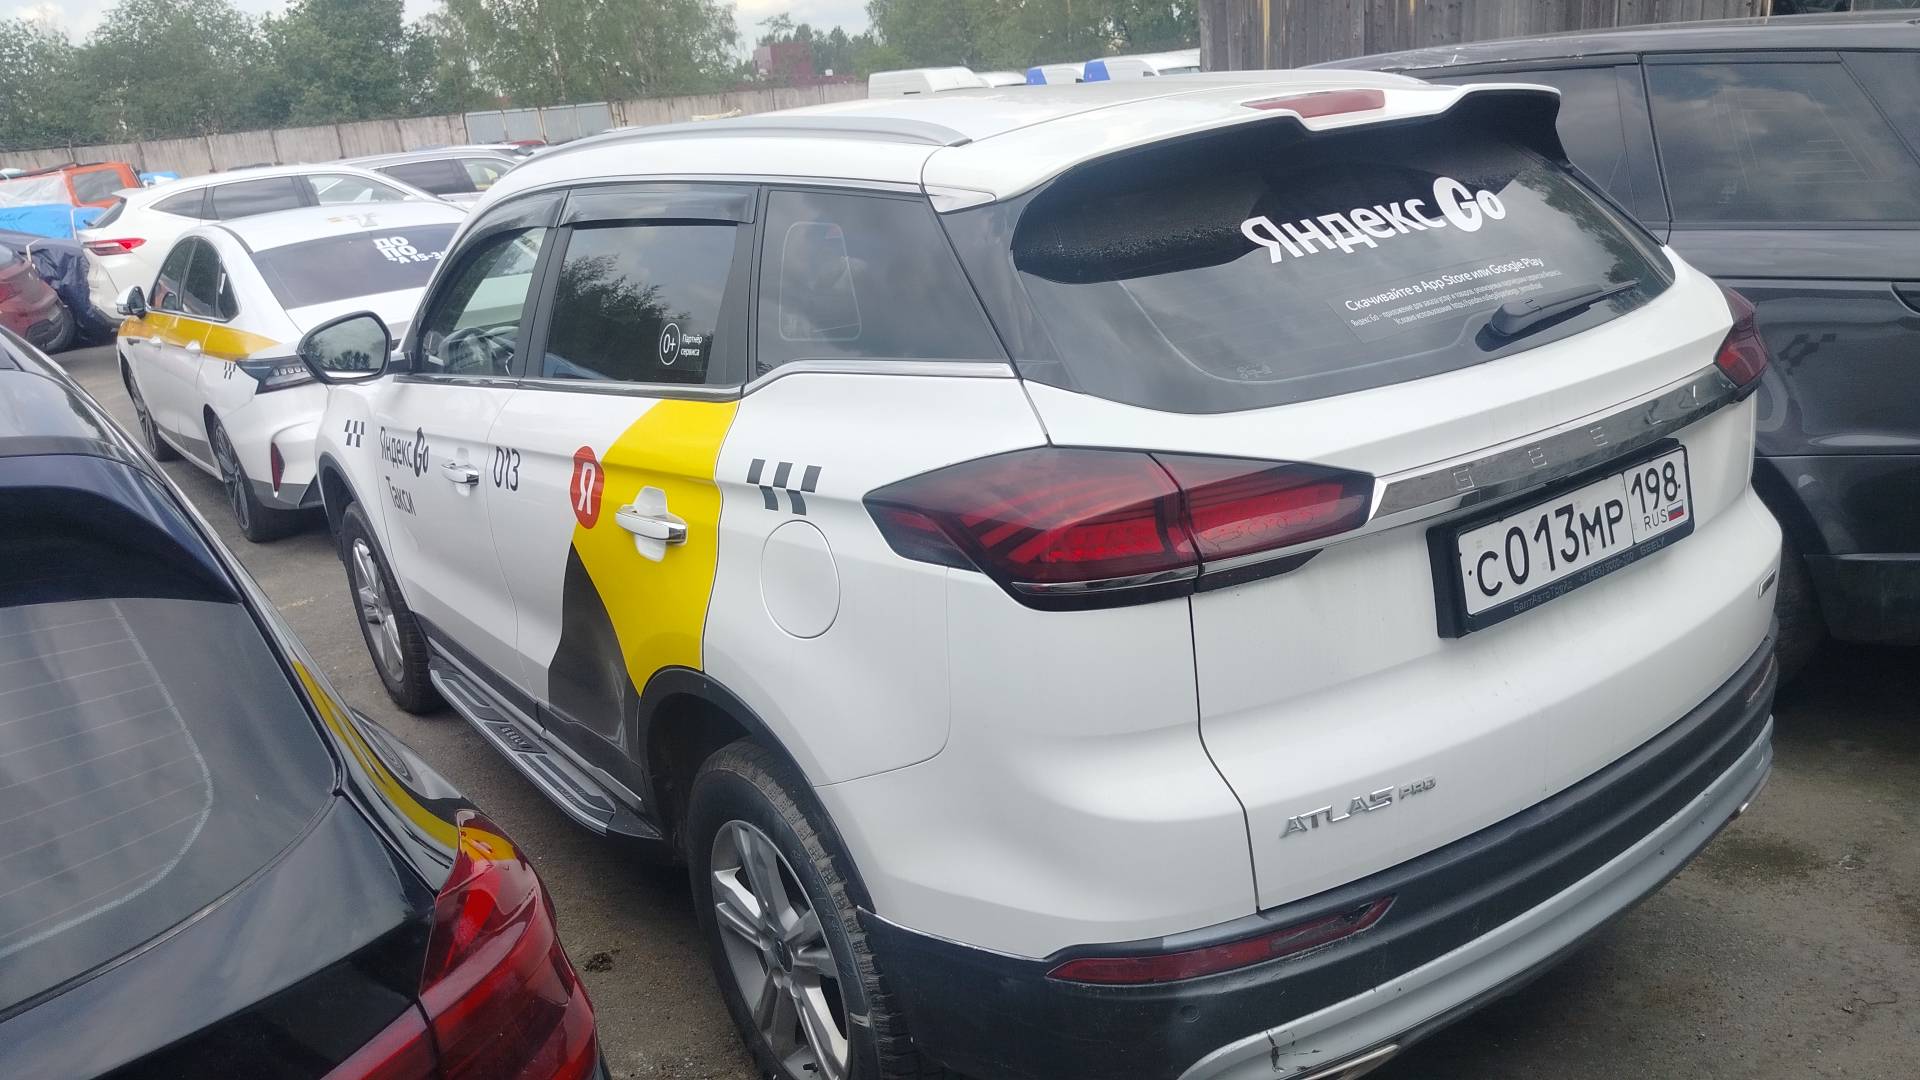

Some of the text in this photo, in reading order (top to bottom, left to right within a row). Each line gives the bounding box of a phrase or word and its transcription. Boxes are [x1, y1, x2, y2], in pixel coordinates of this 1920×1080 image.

[1240, 176, 1506, 263] Яндекс Go
[1345, 256, 1545, 311] Скачивайте в App Store или Google Play
[663, 333, 677, 353] 0+
[380, 426, 430, 477] Яндекс Go
[493, 446, 521, 491] 013
[385, 475, 417, 516] Такси
[577, 461, 596, 516] Я
[1630, 461, 1678, 514] 198
[1644, 509, 1667, 531] RUS
[1640, 537, 1665, 556] GEELY
[1280, 776, 1437, 838] ATLAS PRO
